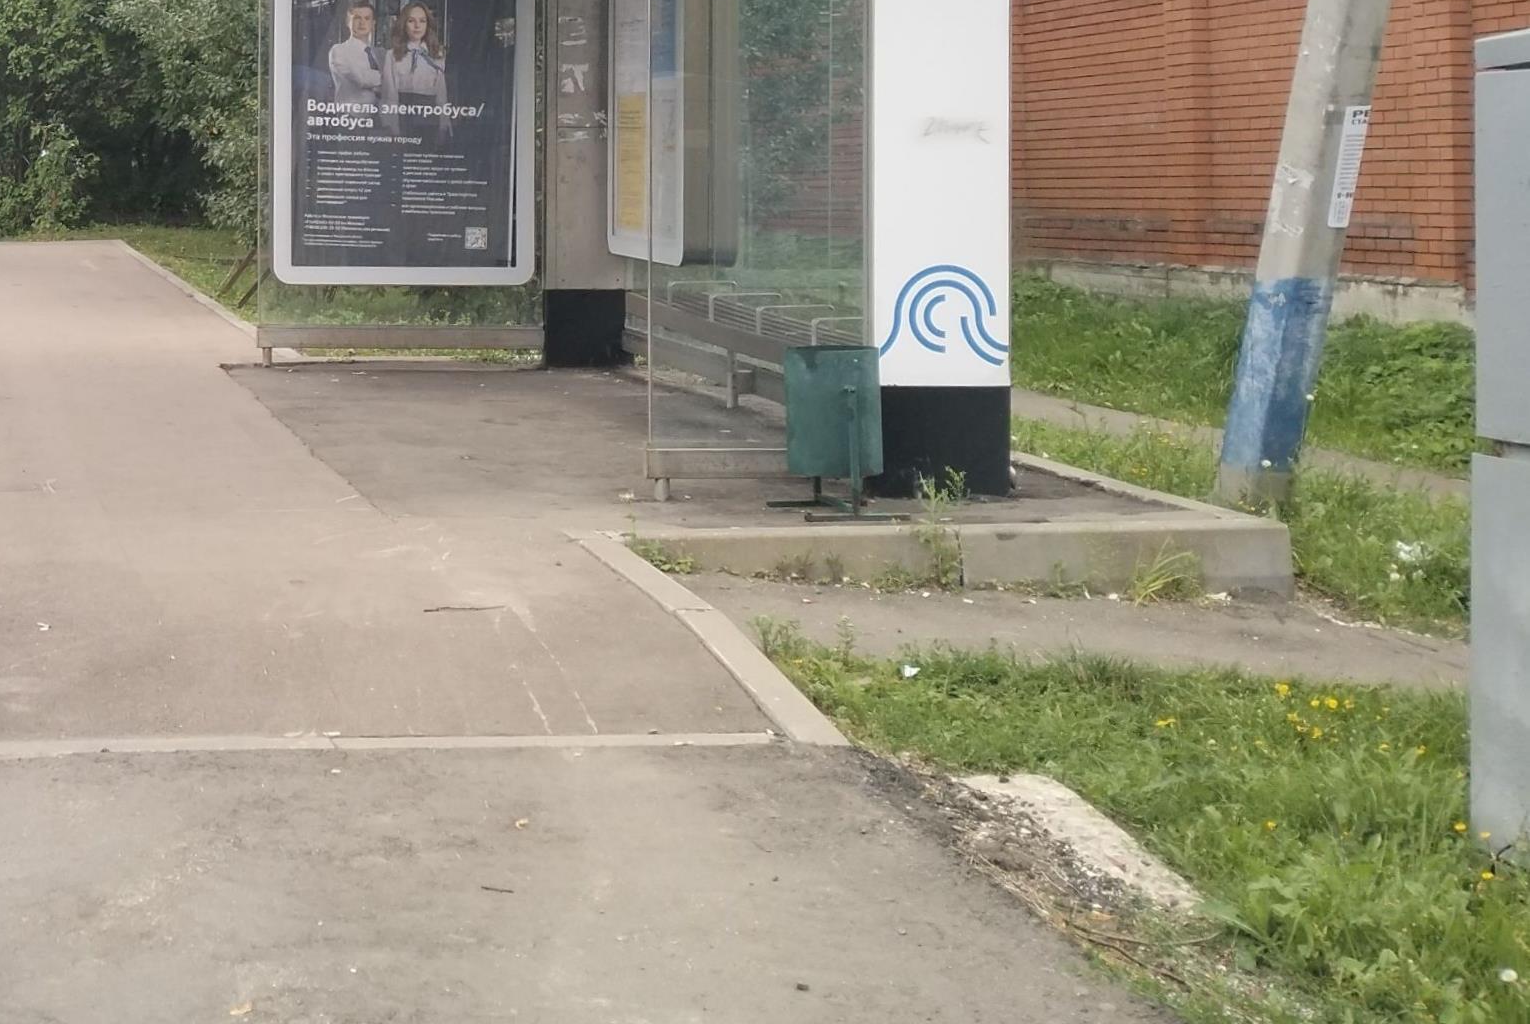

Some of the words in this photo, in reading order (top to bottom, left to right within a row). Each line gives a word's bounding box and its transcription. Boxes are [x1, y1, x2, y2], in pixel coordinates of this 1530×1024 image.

[307, 99, 378, 114] Водитель
[381, 103, 485, 119] электробуса/
[307, 114, 374, 129] автобуса
[306, 132, 320, 141] Эта
[322, 133, 366, 143] профессия
[367, 135, 392, 144] нужна
[394, 136, 422, 145] городу
